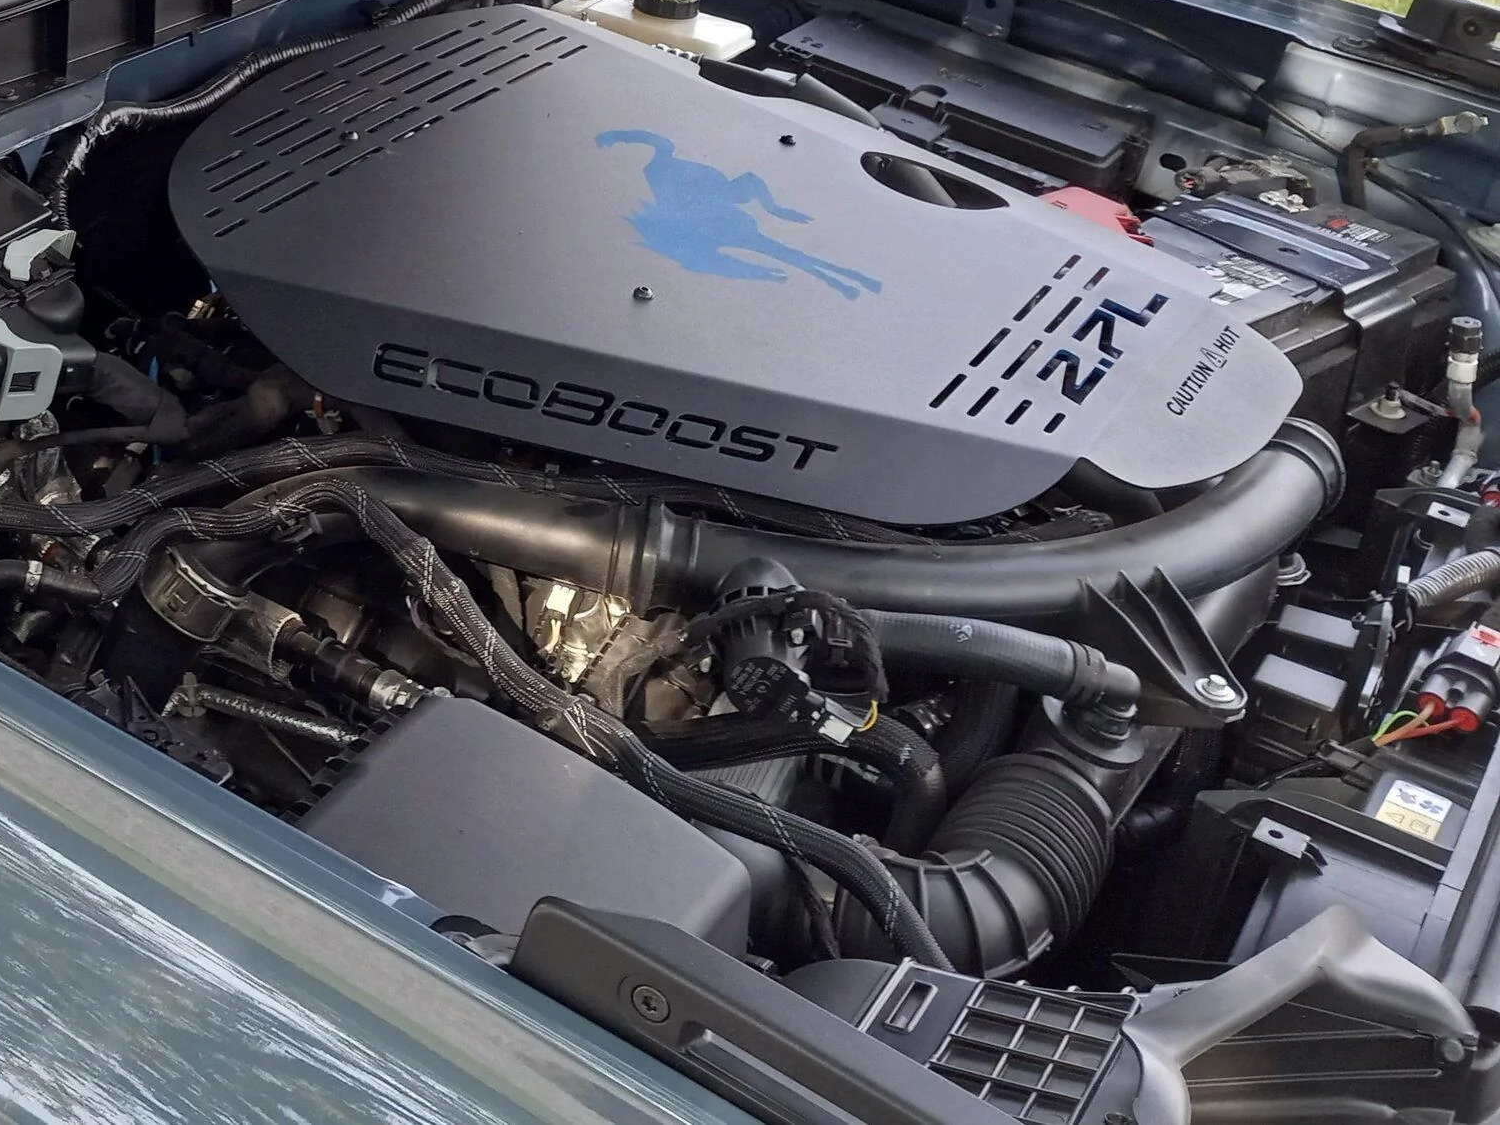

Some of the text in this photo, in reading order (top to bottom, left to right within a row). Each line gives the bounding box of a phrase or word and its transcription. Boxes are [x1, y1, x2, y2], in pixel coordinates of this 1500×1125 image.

[371, 341, 839, 471] ECOBOOST
[1036, 293, 1170, 406] 2.7L
[1166, 325, 1241, 416] CAUTION HOT
